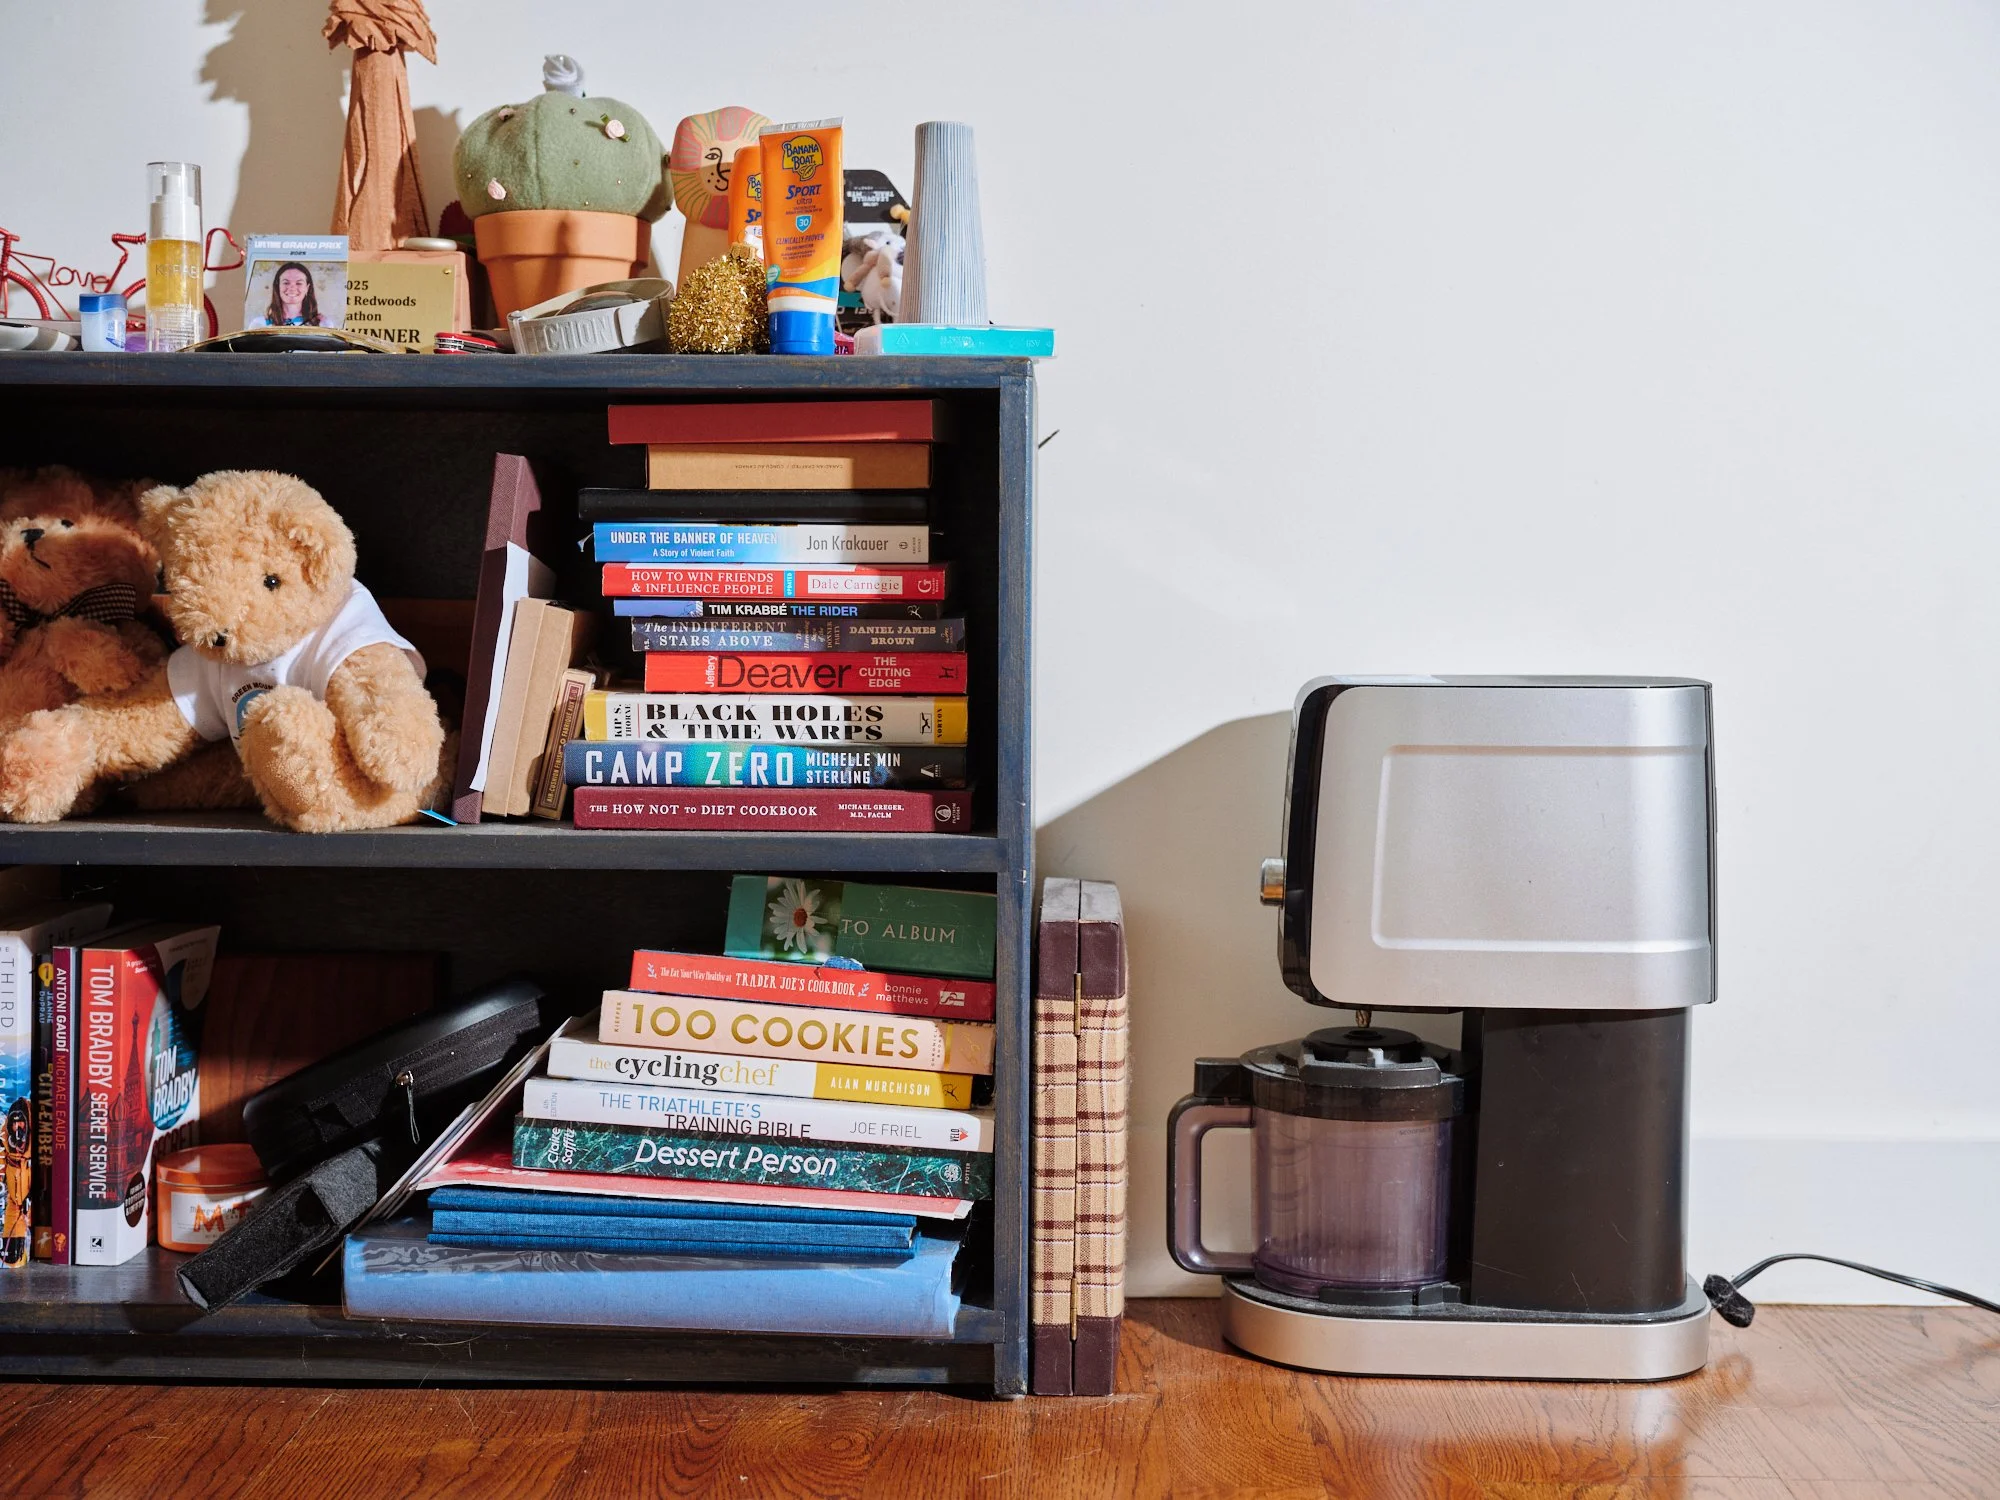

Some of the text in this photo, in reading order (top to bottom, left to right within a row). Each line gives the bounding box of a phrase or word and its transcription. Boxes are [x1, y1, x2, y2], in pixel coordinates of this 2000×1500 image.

[783, 142, 819, 157] BANANA
[786, 184, 822, 200] SPORT
[798, 218, 809, 227] 30
[282, 241, 318, 249] GRAND
[318, 241, 343, 249] PRIX
[345, 280, 369, 291] 025
[354, 295, 417, 307] Redwoods
[610, 531, 778, 545] UNDER THE BANNER OF HEAVEN
[806, 535, 889, 552] Jon Krakauer
[653, 548, 735, 559] A Story of Violent Faith
[631, 571, 774, 583] HOW TO WIN FRIENDS
[786, 572, 794, 597] UPDATED
[631, 583, 774, 595] & INFLUENCE PEOPLE
[811, 578, 900, 594] Dale Carnegie
[708, 603, 858, 617] TIM KRABBÉ THE RIDER
[644, 621, 787, 634] The INDIFFERENT
[849, 626, 937, 635] DANIEL JAMES
[659, 635, 773, 647] STARS ABOVE
[871, 636, 915, 646] BROWN
[873, 656, 897, 667] THE
[705, 655, 716, 688] Jeffery
[717, 655, 852, 689] Deaver
[858, 667, 911, 678] CUTTING
[868, 678, 902, 688] EDGE
[231, 682, 274, 703] GREEN MOUN
[613, 703, 623, 738] KIP S.
[624, 703, 632, 737] THORNE
[646, 704, 884, 722] BLACK HOLES
[646, 723, 884, 741] & TIME WARPS
[806, 751, 901, 768] MICHELLE MIN
[585, 750, 794, 786] CAMP ZERO
[806, 770, 871, 785] STERLING
[589, 804, 608, 813] THE
[612, 804, 645, 815] HOW
[649, 804, 680, 815] NOT
[701, 805, 736, 816] DIET
[739, 805, 818, 816] COOKBOOK
[838, 803, 905, 813] MICHAEL GREGER,
[867, 811, 892, 819] FACLM
[841, 918, 956, 944] TO ALBUM
[660, 966, 670, 977] The
[670, 967, 679, 977] Eat
[680, 968, 693, 979] Your
[693, 970, 705, 981] Way
[705, 970, 725, 983] Healthy
[735, 972, 777, 989] TRADER
[779, 976, 805, 993] JOE'S
[807, 977, 855, 996] COOKBOOK
[884, 983, 922, 995] bonnie
[1, 958, 14, 1028] THIRD
[876, 993, 929, 1005] matthews
[632, 1003, 919, 1059] 100 COOKIES
[56, 967, 69, 1150] ANTONI GAUDÍ MICHAEL EAUDE
[154, 1045, 177, 1087] TOM
[589, 1056, 612, 1070] the
[89, 965, 114, 1199] TOM BRADBY SECRET SERVICE
[830, 1076, 931, 1097] ALAN MURCHISON
[153, 1068, 197, 1122] BRADBY
[599, 1092, 761, 1119] THE TRIATHLETE'S
[38, 1073, 53, 1166] CITY EMBER
[665, 1113, 811, 1139] TRAINING BIBLE
[849, 1121, 922, 1139] JOE FRIEL
[950, 1127, 960, 1143] VELO
[548, 1126, 561, 1164] Claire
[562, 1128, 577, 1165] Saffitz
[634, 1138, 838, 1177] Dessert Person
